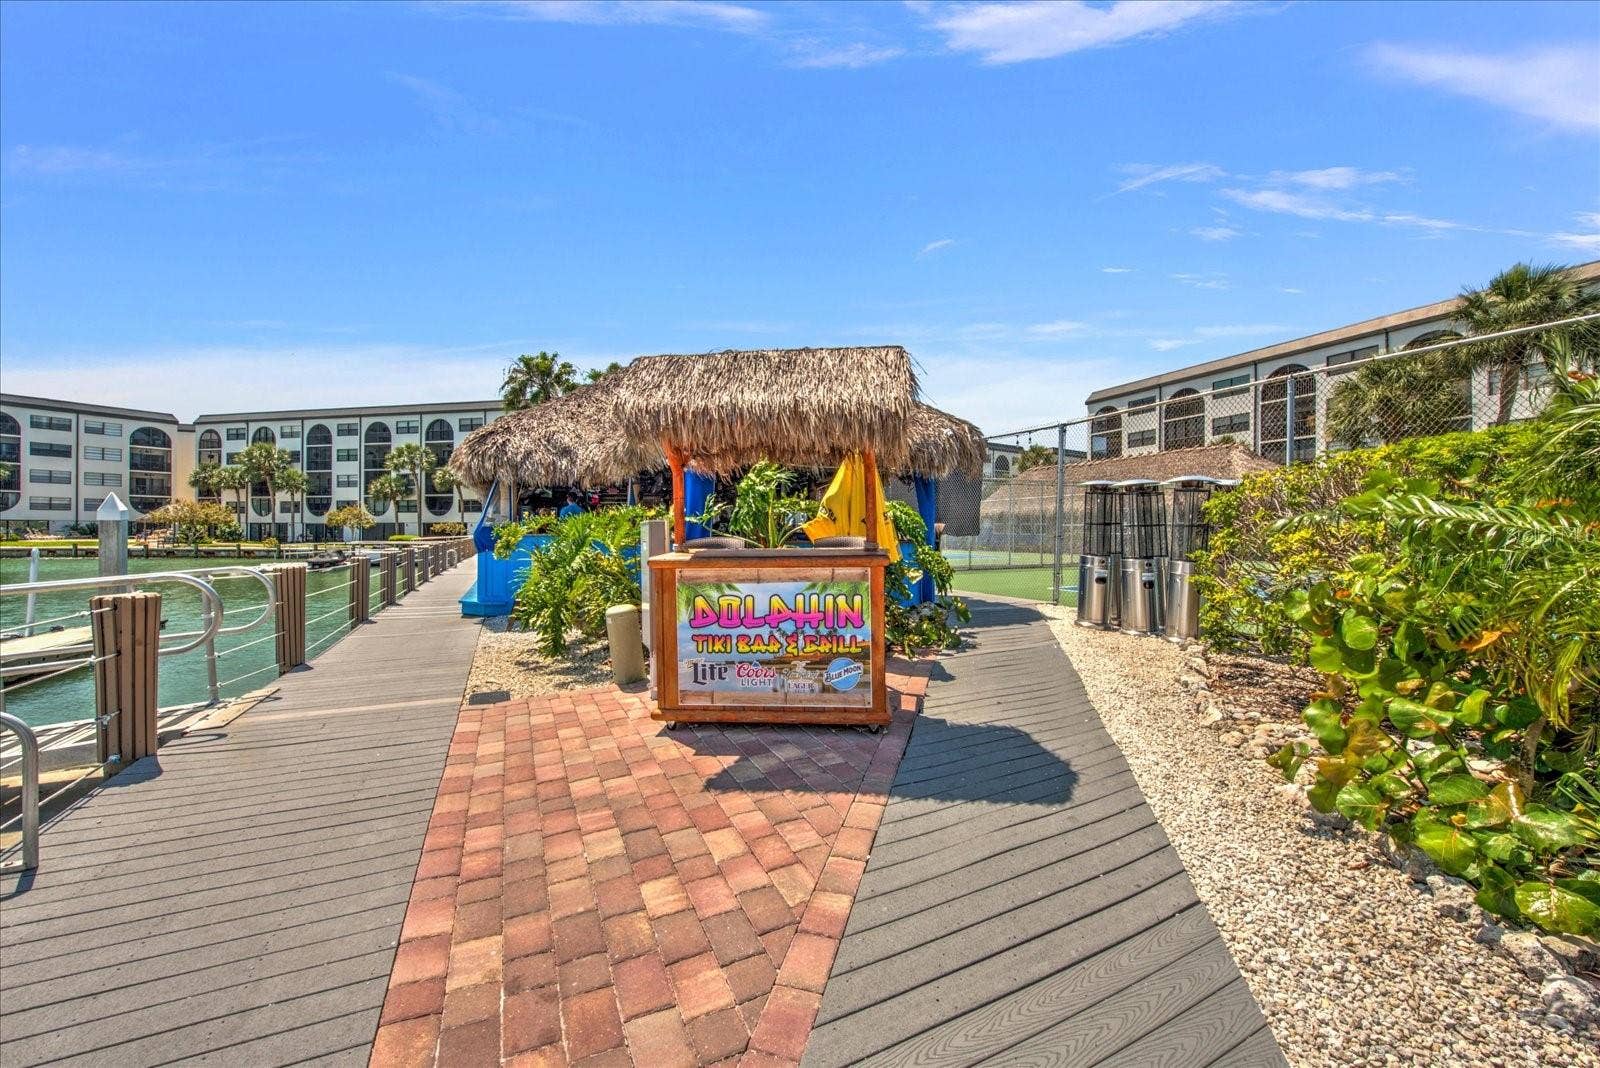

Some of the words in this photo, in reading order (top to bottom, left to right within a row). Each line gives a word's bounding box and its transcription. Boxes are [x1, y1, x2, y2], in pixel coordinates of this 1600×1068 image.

[690, 594, 864, 629] DOLPHIN
[692, 634, 732, 653] TIKI
[736, 634, 782, 654] BAR
[803, 634, 862, 653] GRILL
[692, 662, 728, 685] Lite
[736, 663, 776, 678] Coors
[825, 671, 842, 683] BLUE
[843, 664, 862, 676] MOON
[741, 678, 772, 687] LIGHT
